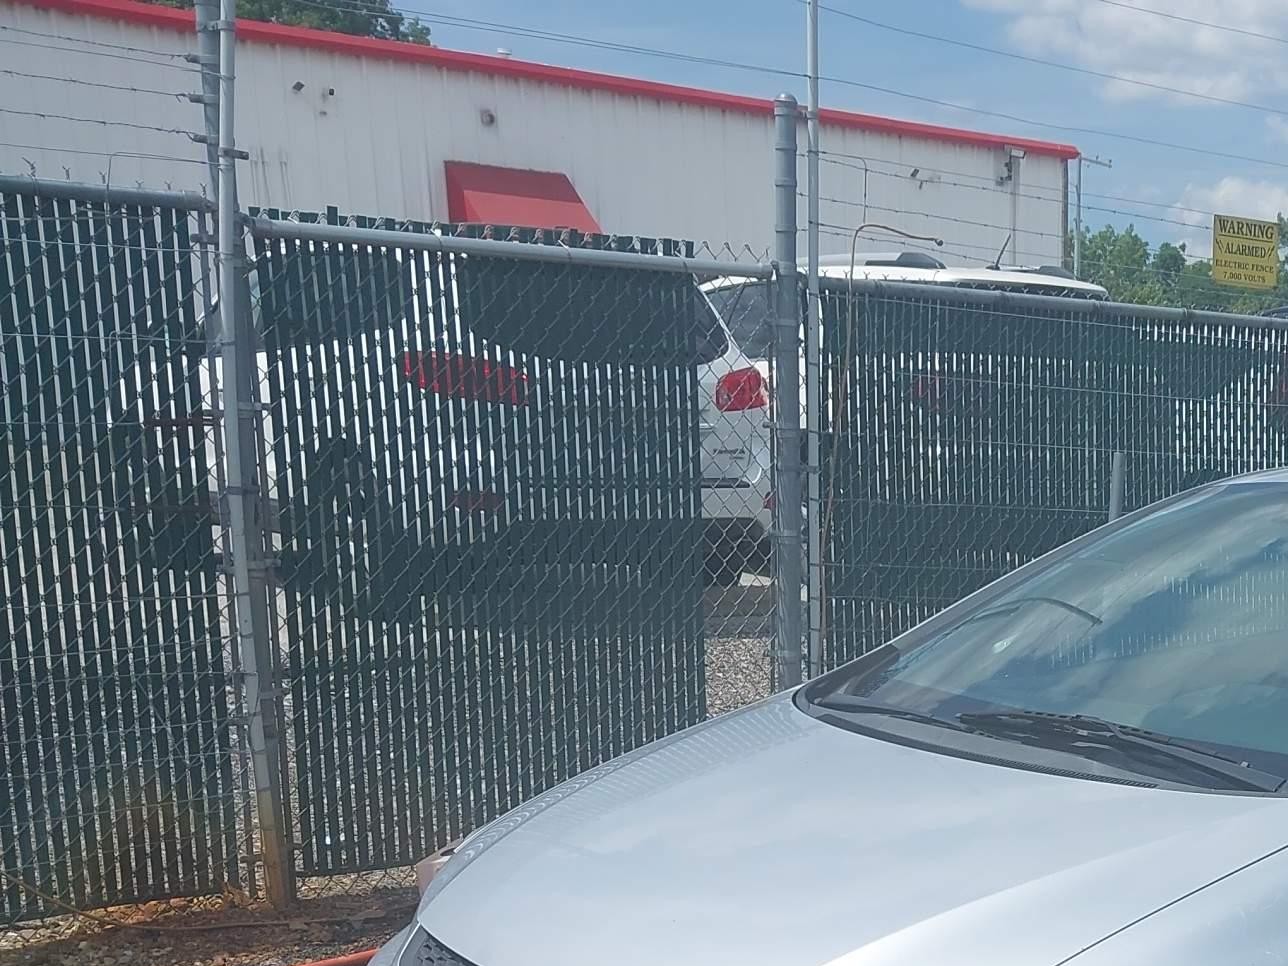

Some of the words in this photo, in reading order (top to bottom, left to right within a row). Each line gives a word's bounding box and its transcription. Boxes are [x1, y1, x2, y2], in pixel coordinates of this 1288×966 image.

[1218, 218, 1275, 241] WARNING
[1224, 242, 1268, 259] ALARMED
[1215, 258, 1250, 271] ELECTRIC
[1251, 263, 1275, 274] FENCE
[1223, 271, 1243, 280] 7,000
[1243, 273, 1267, 284] VOLTS
